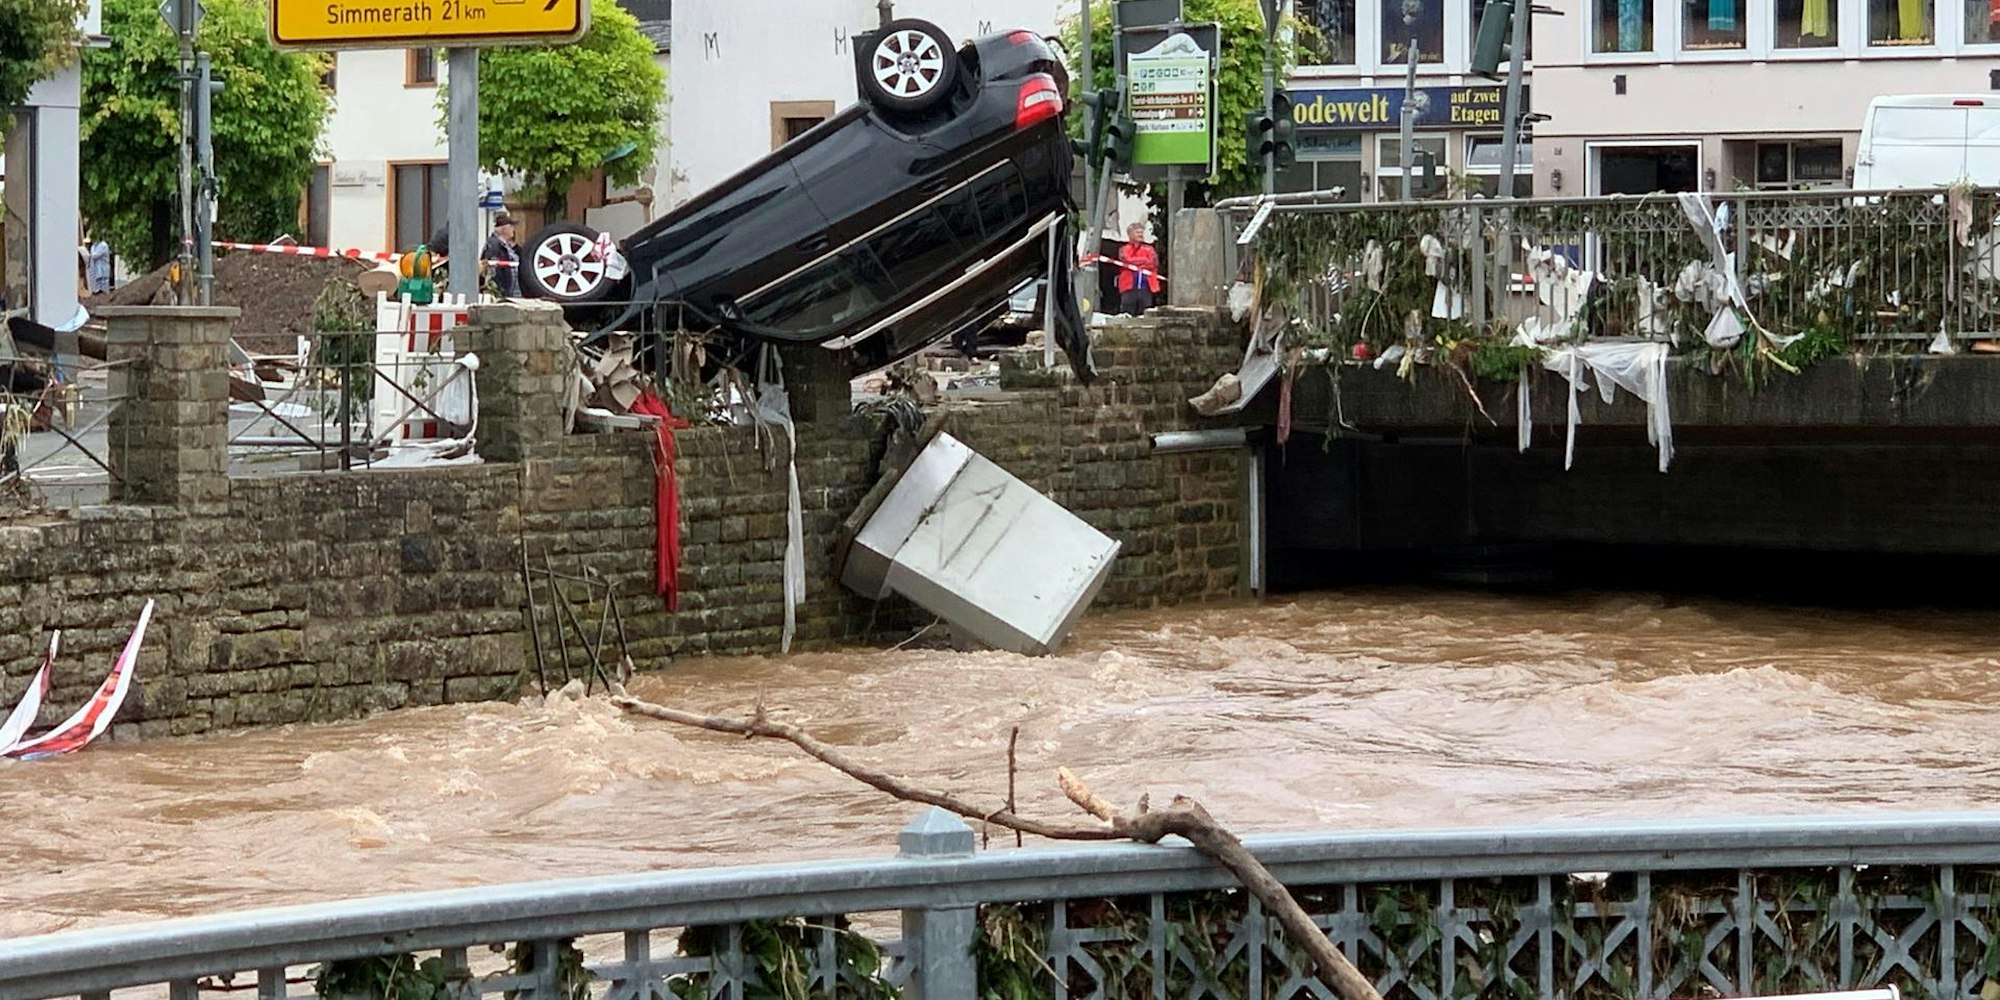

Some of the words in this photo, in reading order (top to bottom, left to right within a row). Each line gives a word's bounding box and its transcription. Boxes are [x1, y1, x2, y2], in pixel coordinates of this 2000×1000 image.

[327, 4, 431, 24] Simmerath
[442, 0, 460, 20] 21
[465, 5, 486, 20] km
[1451, 88, 1471, 103] auf
[1473, 88, 1500, 103] zwei
[1293, 93, 1389, 125] odewelt
[1451, 106, 1500, 126] Etagen
